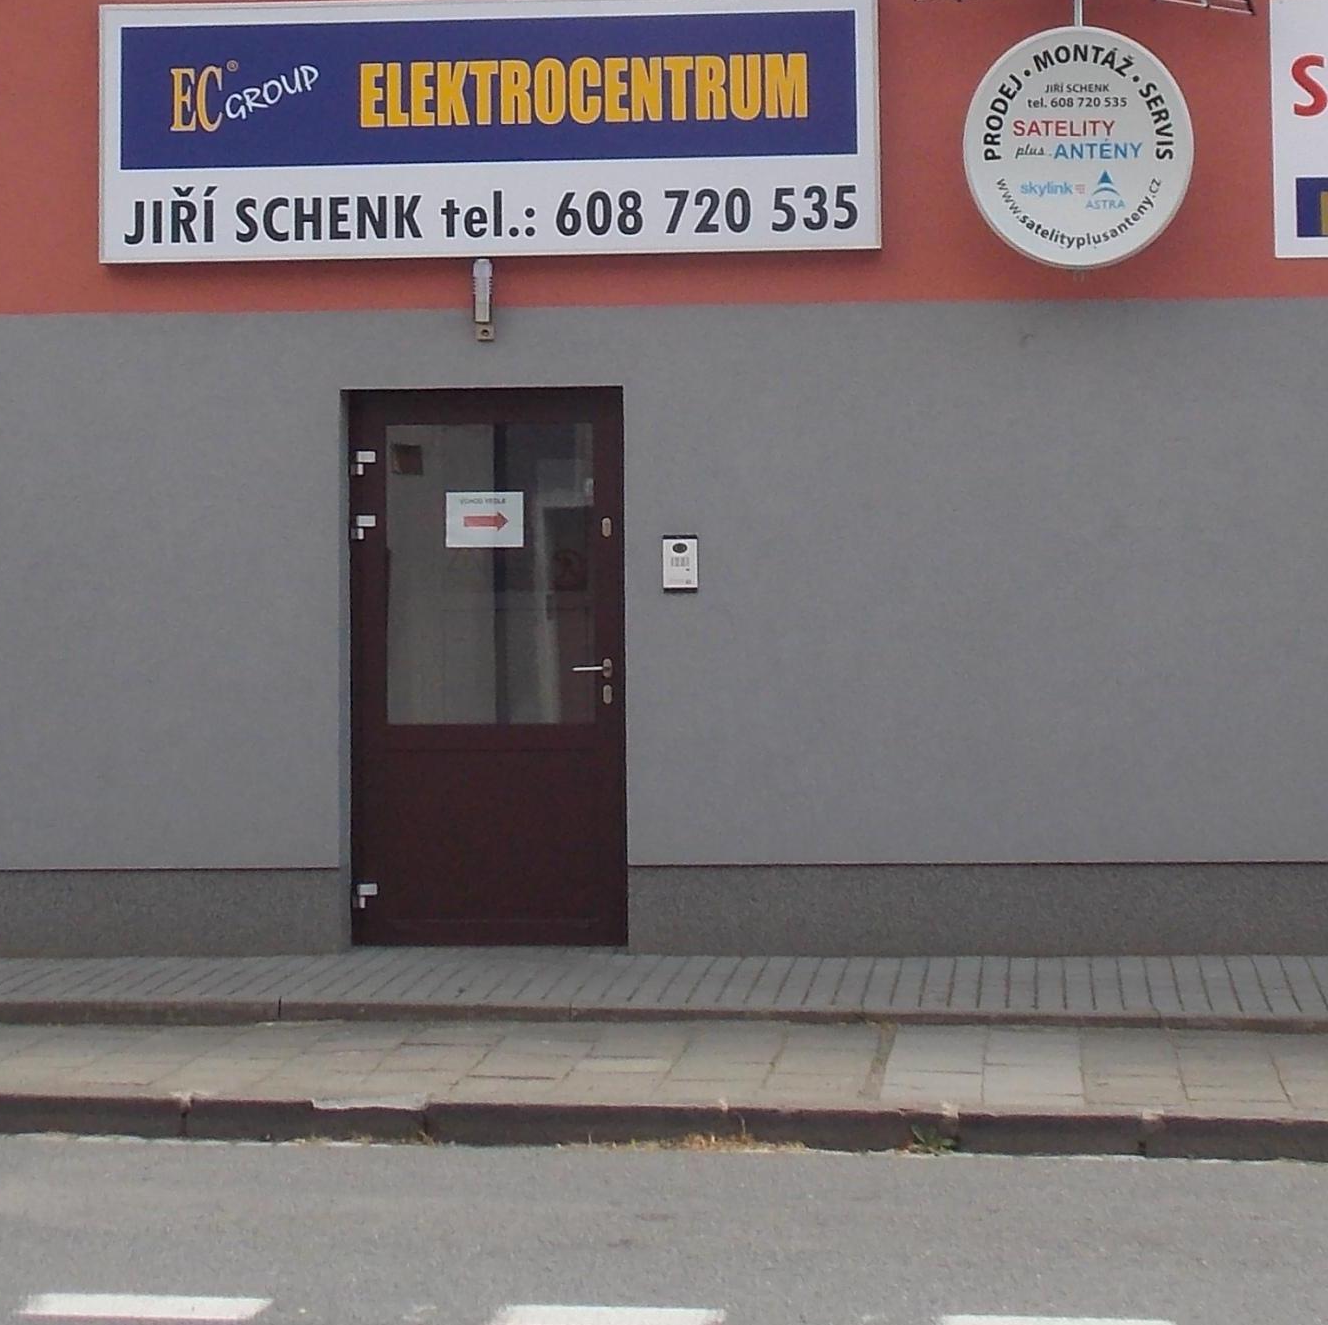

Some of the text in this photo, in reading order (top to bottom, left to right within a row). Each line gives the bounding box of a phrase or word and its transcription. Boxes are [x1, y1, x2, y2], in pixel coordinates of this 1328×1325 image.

[225, 64, 320, 120] GROUP
[358, 52, 810, 128] ELEKTROCENTRUM
[1066, 83, 1110, 93] SCHENK
[983, 44, 1173, 161] PRODEJ MONTÁŽ SERVIS
[1027, 97, 1128, 109] tel. 608 720 535
[1013, 120, 1116, 137] SATELITY
[1015, 138, 1143, 159] plus ANTÉNY
[1020, 181, 1074, 197] skylink
[1085, 199, 1126, 210] ASTRA
[124, 184, 858, 245] JIŘÍ SCHENK tel.: 608 720 535
